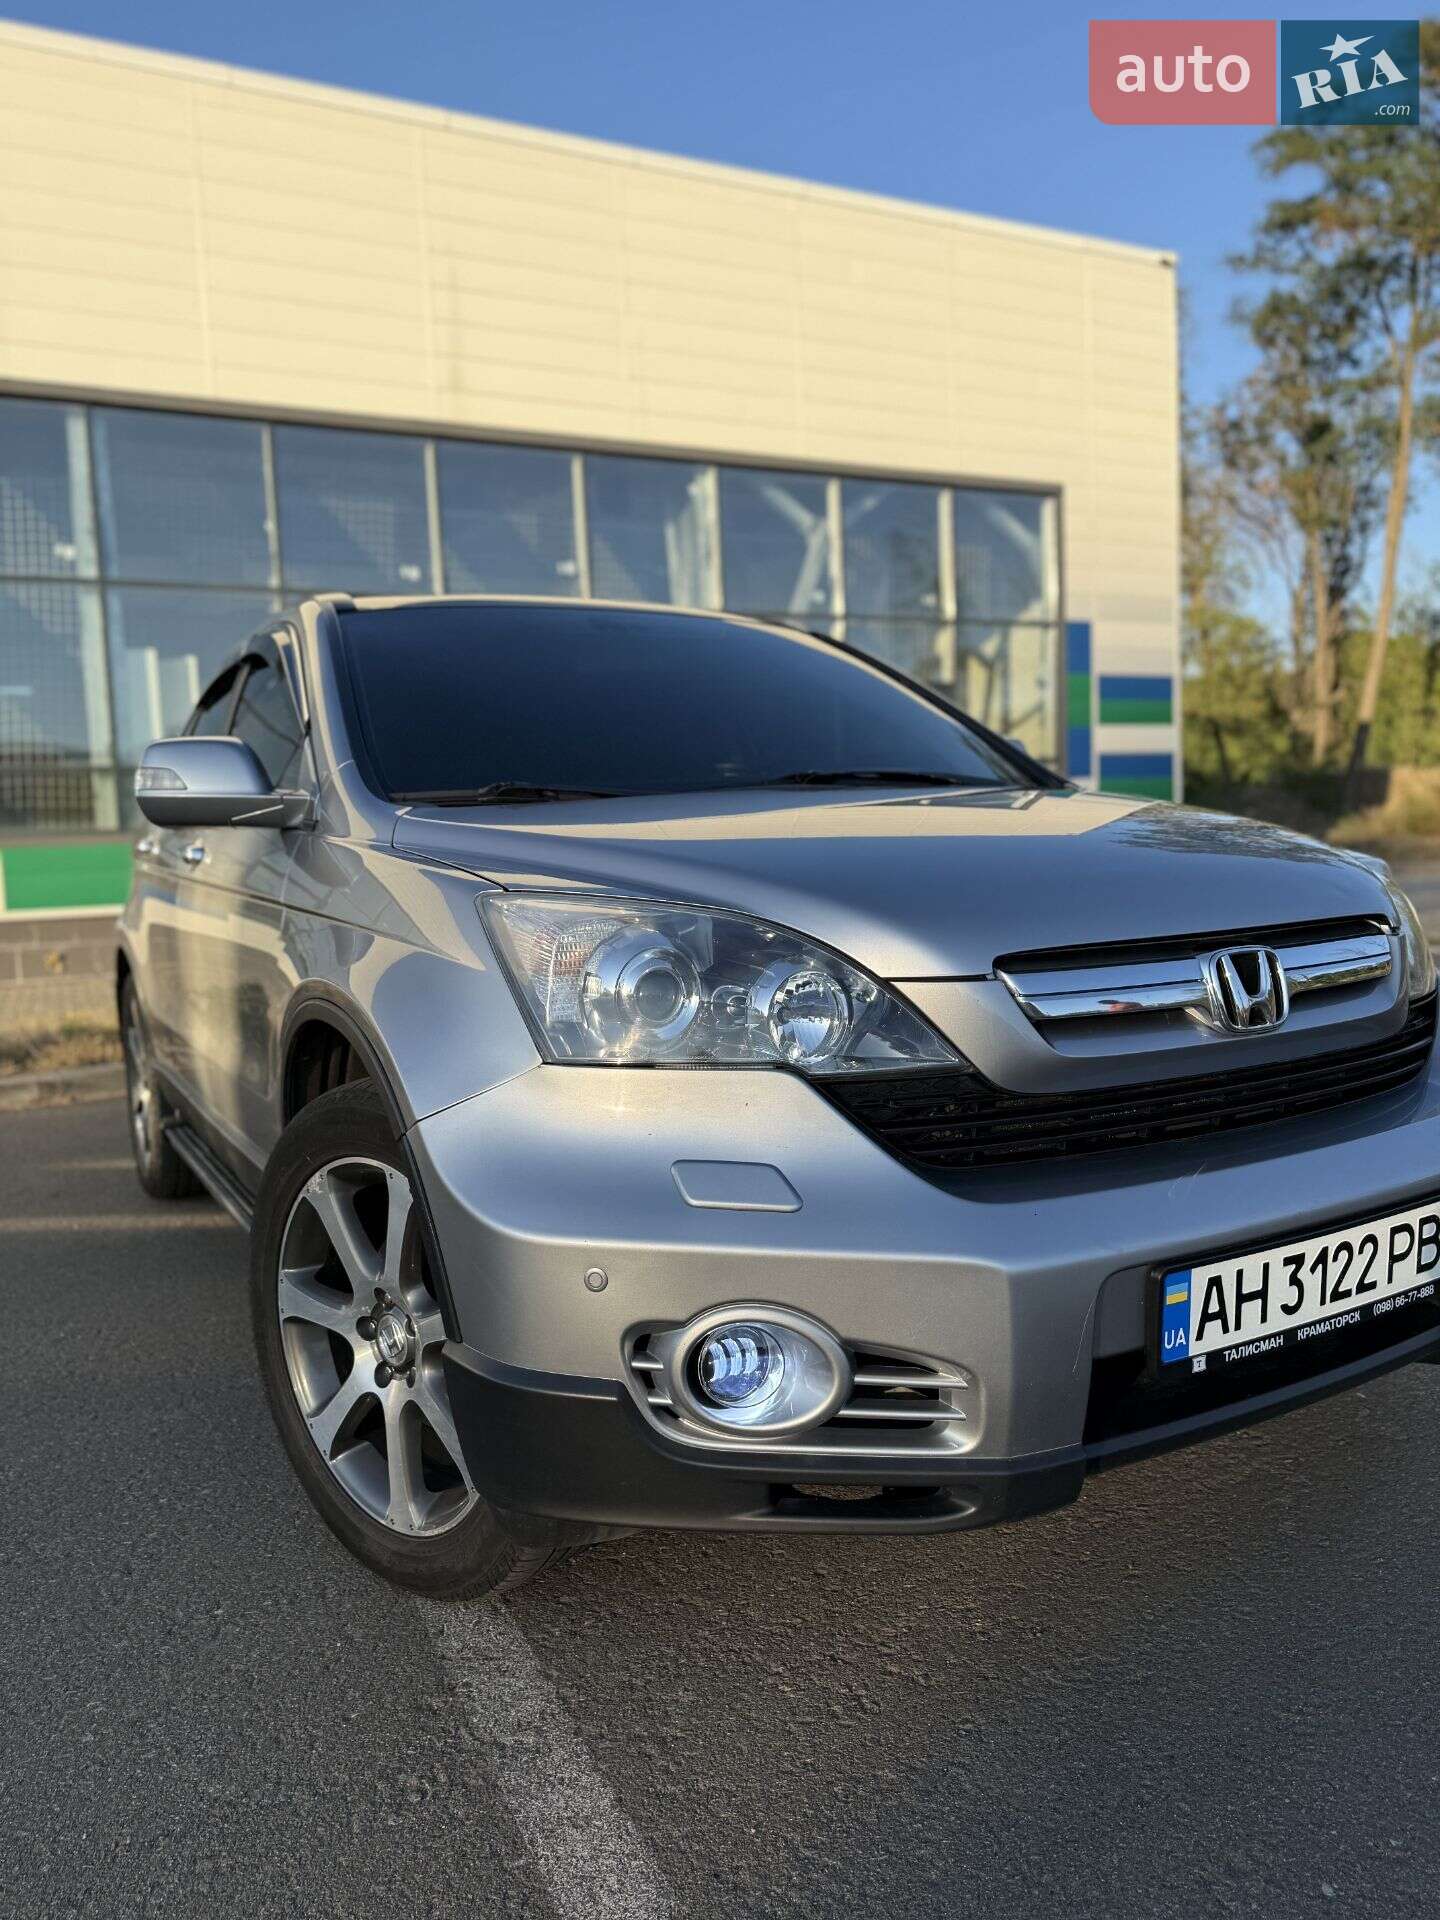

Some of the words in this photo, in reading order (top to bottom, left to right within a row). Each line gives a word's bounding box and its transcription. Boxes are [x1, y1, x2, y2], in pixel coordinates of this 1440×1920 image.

[1195, 1262, 1270, 1342] AH
[1280, 1234, 1379, 1316] 3122
[1387, 1214, 1440, 1284] PB
[1164, 1328, 1187, 1350] UA
[1223, 1335, 1284, 1363] ТАЛИСМАН
[1297, 1311, 1361, 1341] КРАМАТОРСК
[1373, 1299, 1394, 1317] (098)
[1395, 1284, 1435, 1309] 66-77-888
